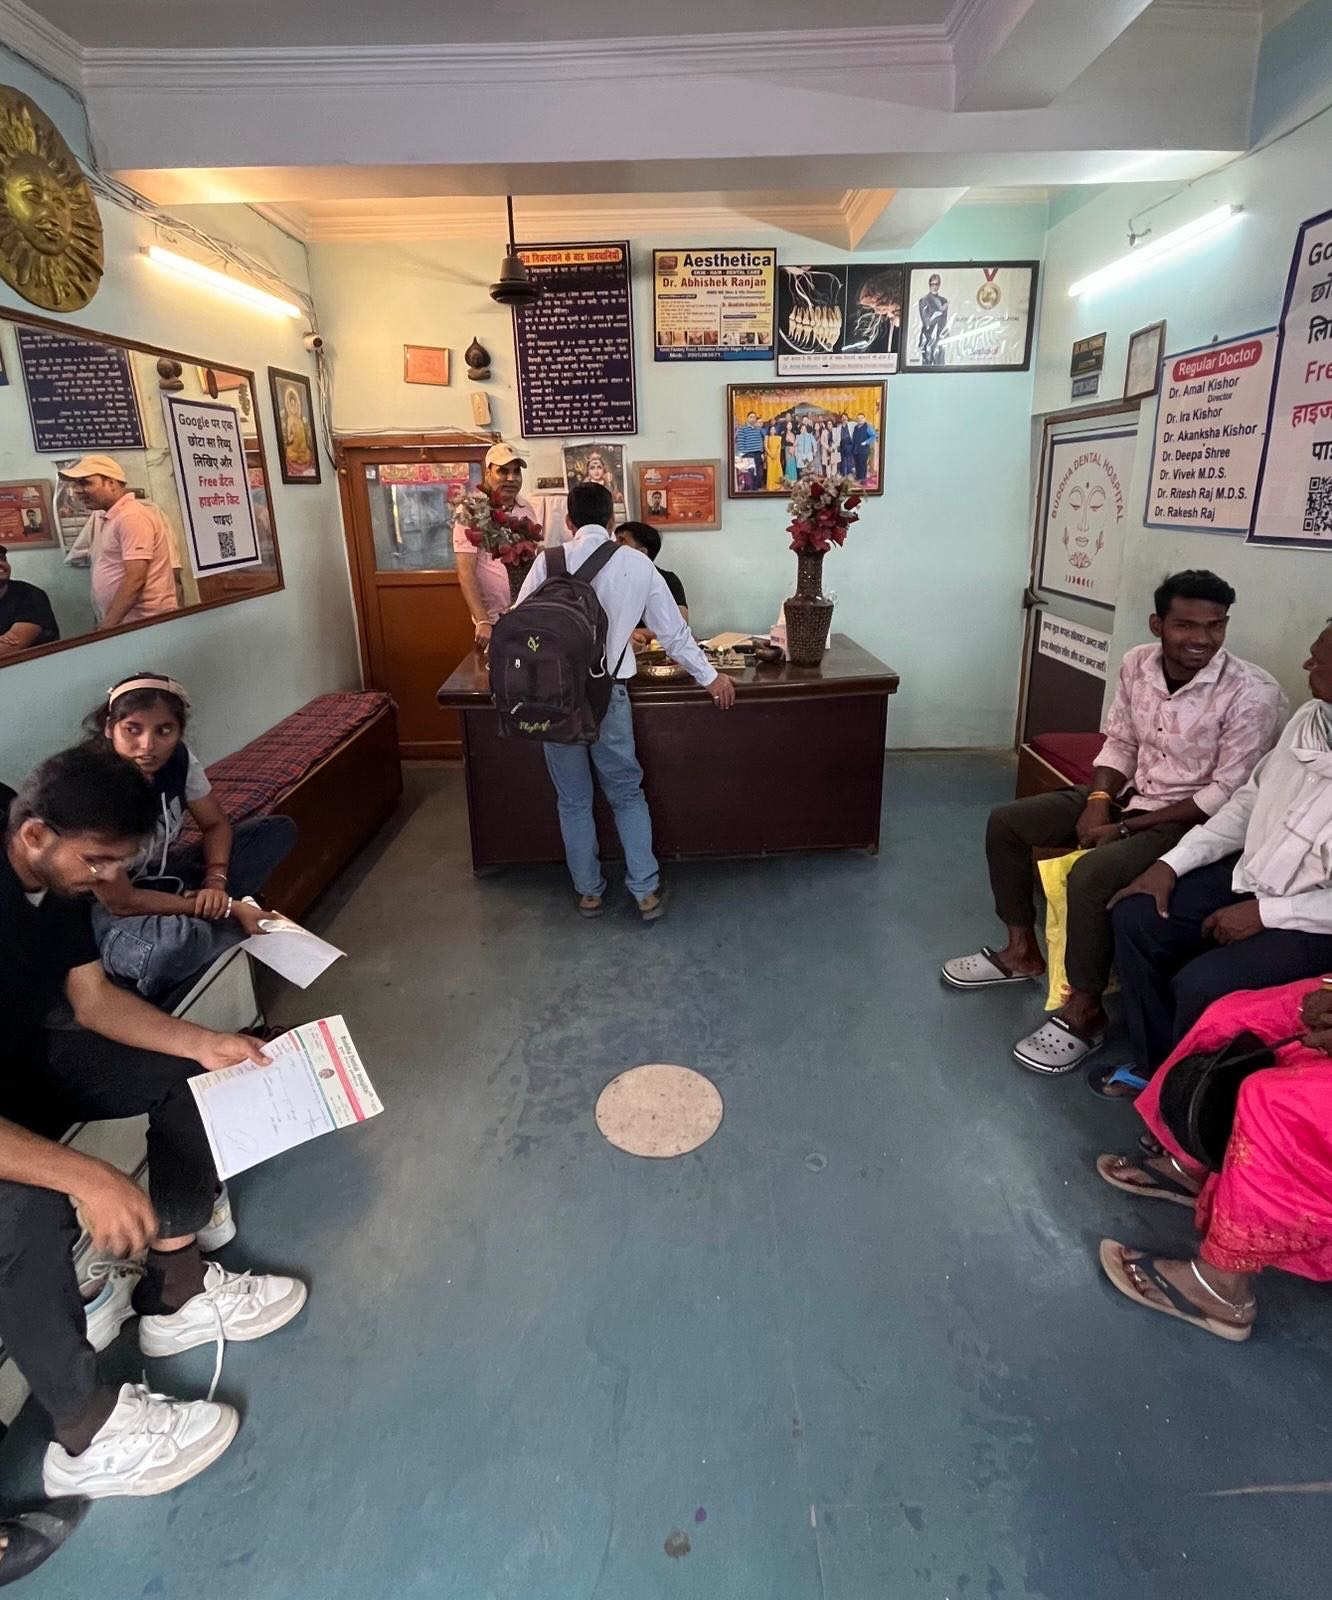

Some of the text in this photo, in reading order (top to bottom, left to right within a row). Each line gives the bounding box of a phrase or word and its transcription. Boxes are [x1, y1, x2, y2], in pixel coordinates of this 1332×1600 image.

[684, 253, 771, 267] Aesthetica
[1309, 243, 1332, 266] Go
[662, 277, 767, 288] Dr. Abhishek Ranjan
[1310, 272, 1332, 303] छो
[1178, 348, 1257, 377] Regular Doctor
[1305, 360, 1332, 384] Fre
[1169, 377, 1240, 399] Dr. Amal Kishor
[1208, 393, 1232, 403] Director
[178, 413, 233, 432] Google पर एक
[1166, 407, 1223, 425] Dr. Ira Kishor
[1292, 400, 1332, 428] हाइज
[187, 433, 206, 447] छोटा
[206, 437, 216, 448] सा
[1164, 424, 1258, 443] Dr. Akanksha Kishor
[1162, 447, 1231, 462] Dr. Deepa Shree
[1312, 441, 1332, 461] पा
[193, 453, 233, 470] लिखिए और
[199, 476, 218, 487] Free
[1160, 467, 1226, 480] Dr. Vivek M.D.S.
[1052, 452, 1124, 524] BUDDHA DENTAL HOSPITAL
[1157, 487, 1248, 502] Dr. Ritesh Raj M.D.S.
[199, 492, 240, 509] हाइजीन किट
[1154, 506, 1215, 522] Dr. Rakesh Raj
